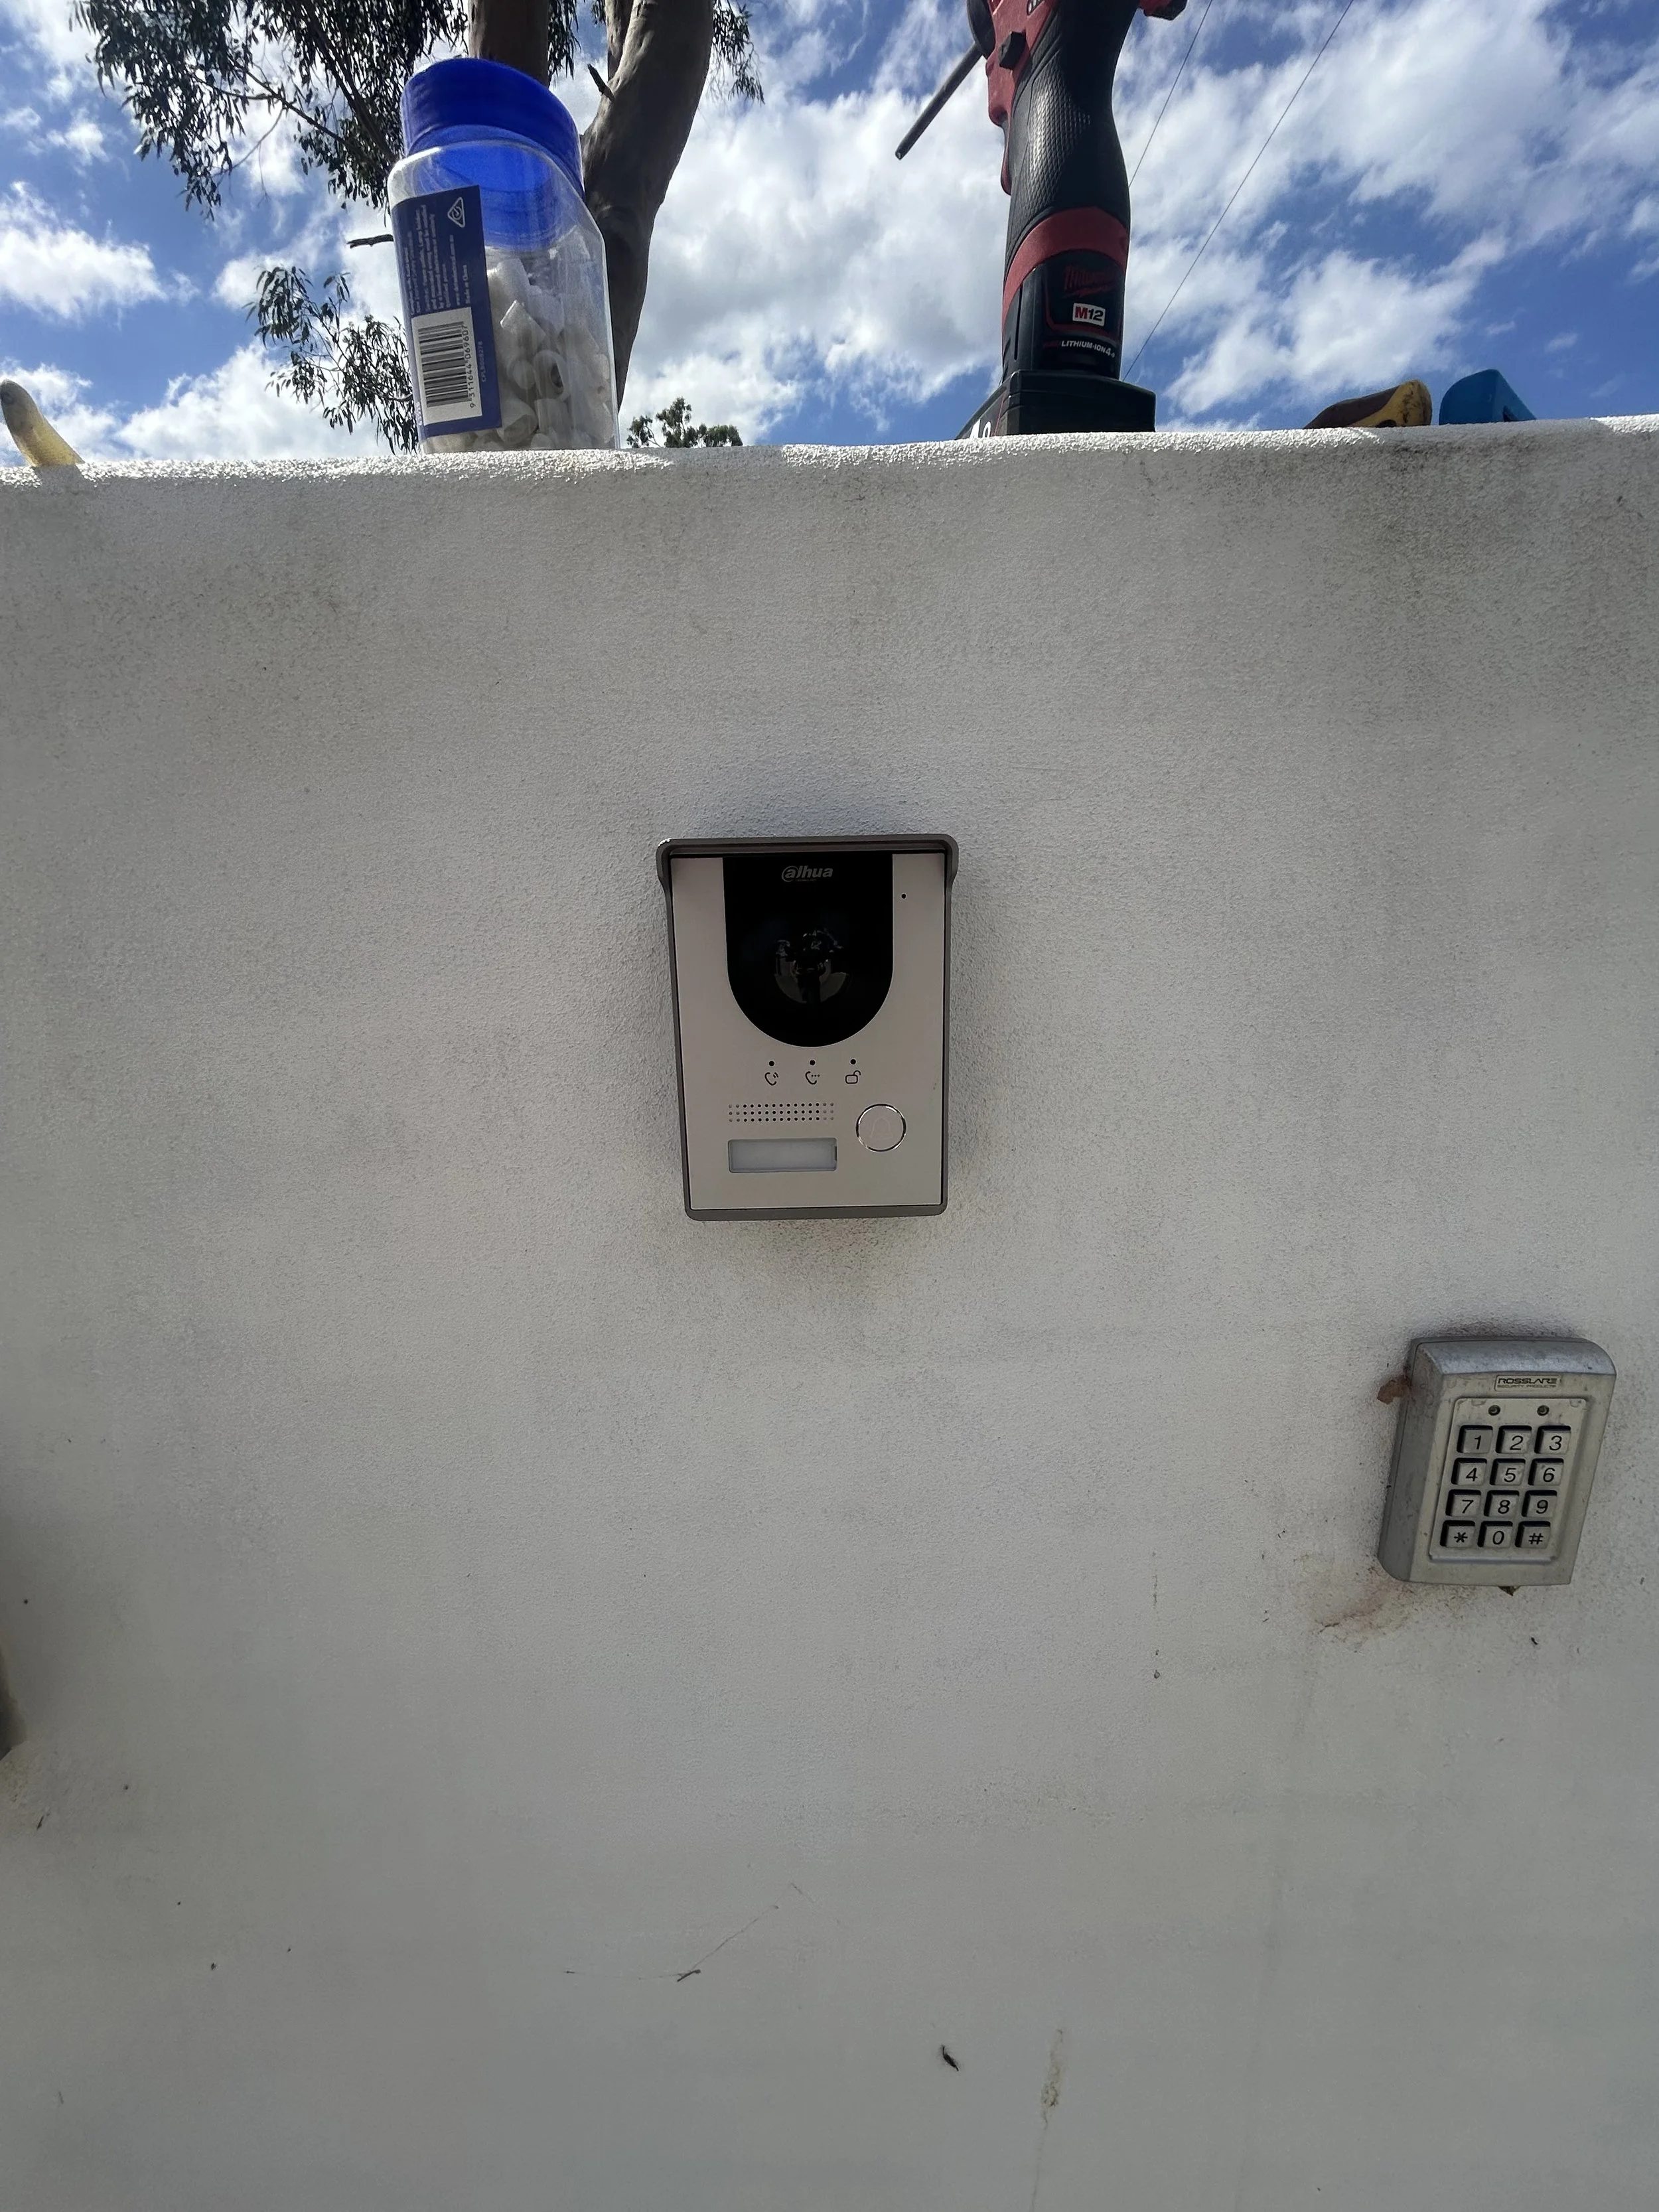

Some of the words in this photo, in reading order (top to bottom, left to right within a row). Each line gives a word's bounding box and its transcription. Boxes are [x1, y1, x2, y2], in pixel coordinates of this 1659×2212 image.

[1074, 306, 1104, 321] M12
[1474, 1435, 1482, 1450] 1
[1509, 1435, 1524, 1451] 2
[1549, 1435, 1562, 1451] 3
[1465, 1467, 1478, 1482] 4
[1503, 1467, 1516, 1483] 5
[1543, 1467, 1555, 1483] 6
[1462, 1499, 1474, 1514] 7
[1498, 1499, 1510, 1514] 8
[1536, 1499, 1548, 1514] 9
[1492, 1530, 1505, 1545] 0
